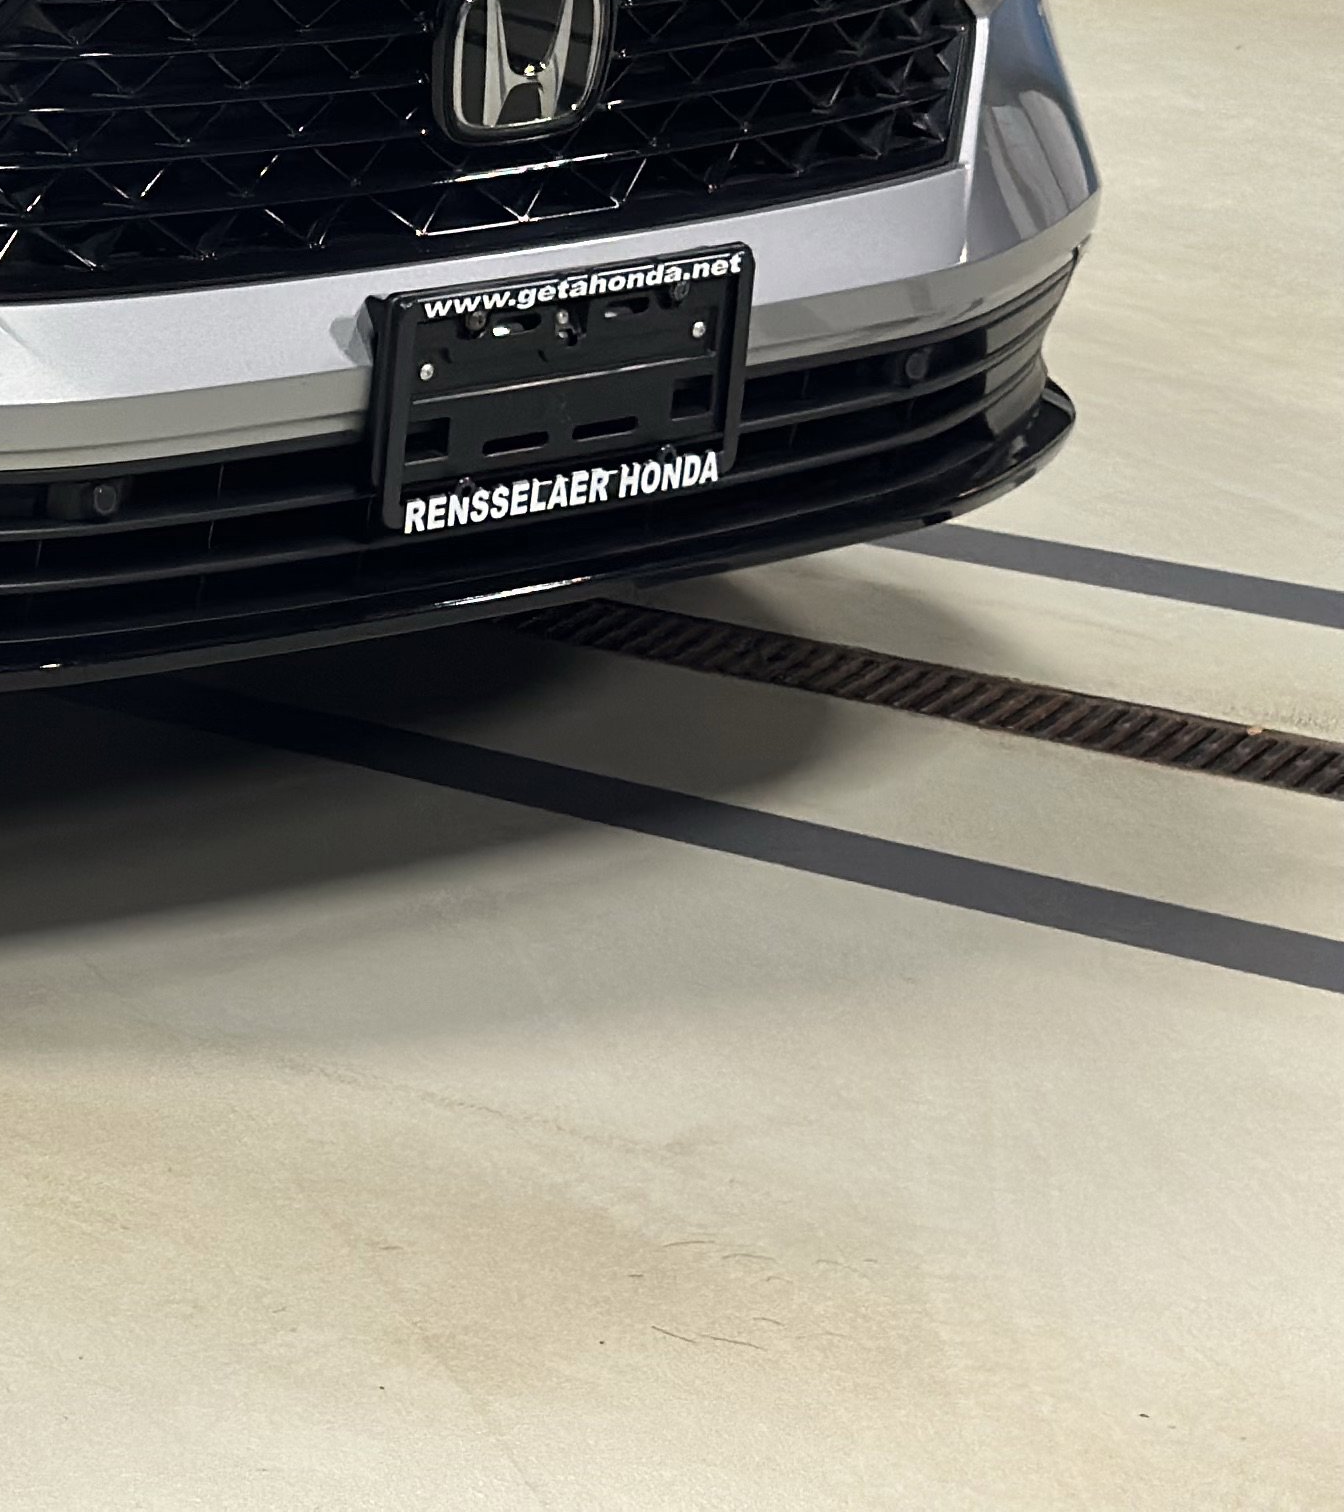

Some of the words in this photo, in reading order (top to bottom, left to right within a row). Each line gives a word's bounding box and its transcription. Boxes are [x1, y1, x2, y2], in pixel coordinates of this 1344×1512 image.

[423, 252, 743, 319] www.getahonda.net
[403, 470, 609, 534] RENSSELAER
[618, 451, 719, 498] HONDA
